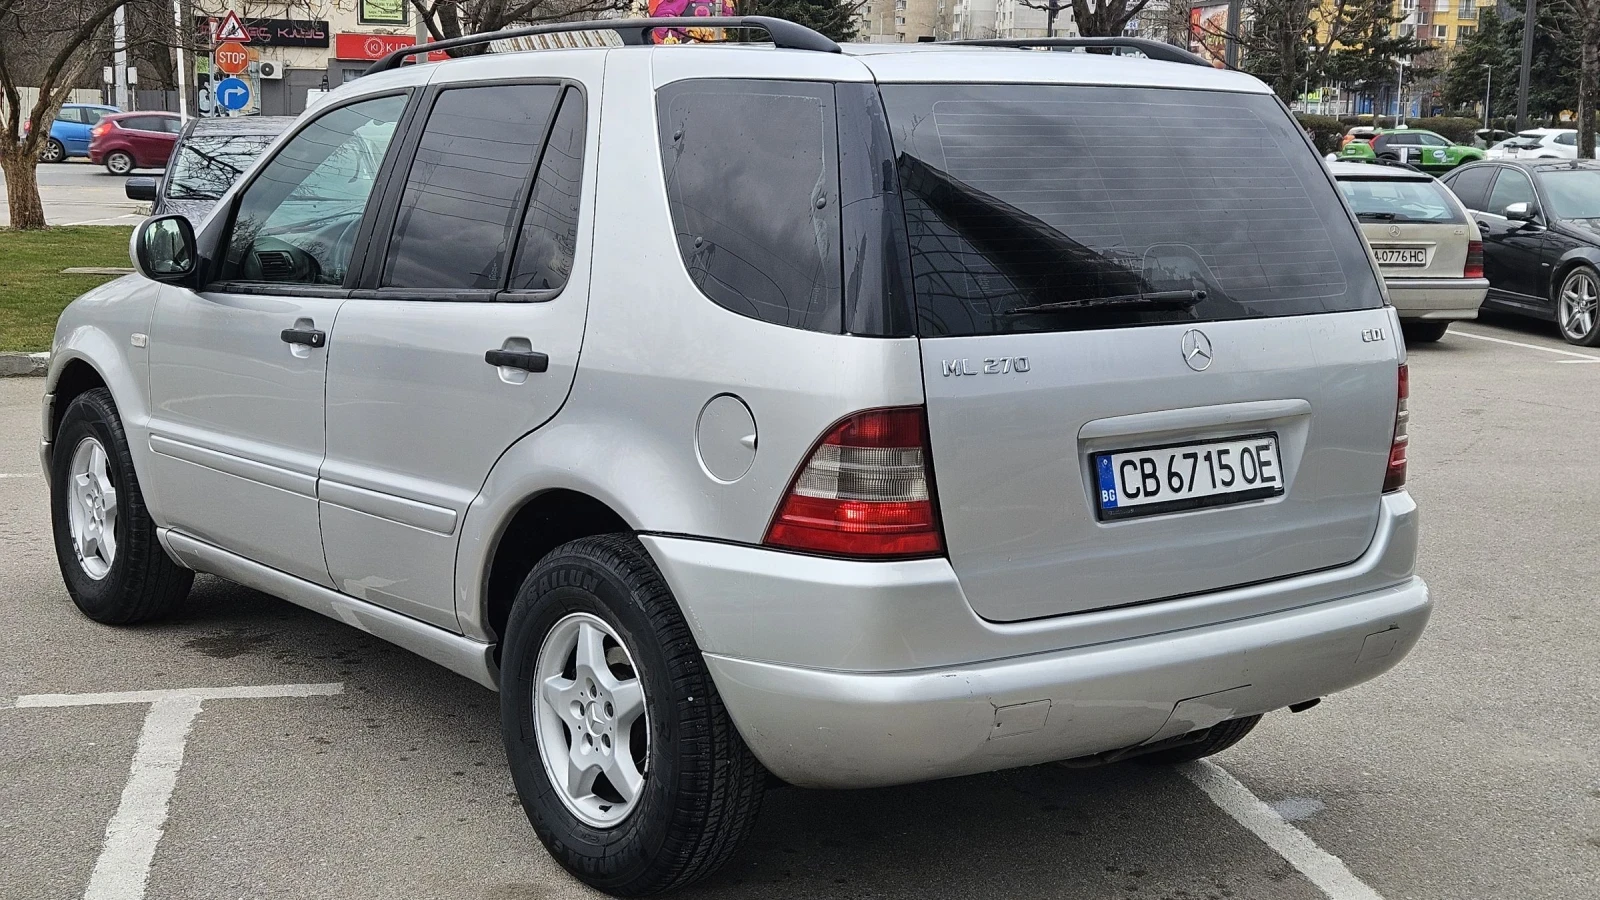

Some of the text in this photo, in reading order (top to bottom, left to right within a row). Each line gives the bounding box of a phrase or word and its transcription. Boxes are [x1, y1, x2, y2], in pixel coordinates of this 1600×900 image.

[219, 52, 246, 64] STOP
[1382, 250, 1408, 262] 0776
[1409, 250, 1424, 262] HC
[1361, 328, 1386, 342] CDI
[942, 356, 1030, 377] ML 270
[1119, 457, 1161, 499] CB
[1167, 449, 1236, 493] 6715
[1102, 489, 1116, 502] BG
[526, 569, 598, 607] SAILUN
